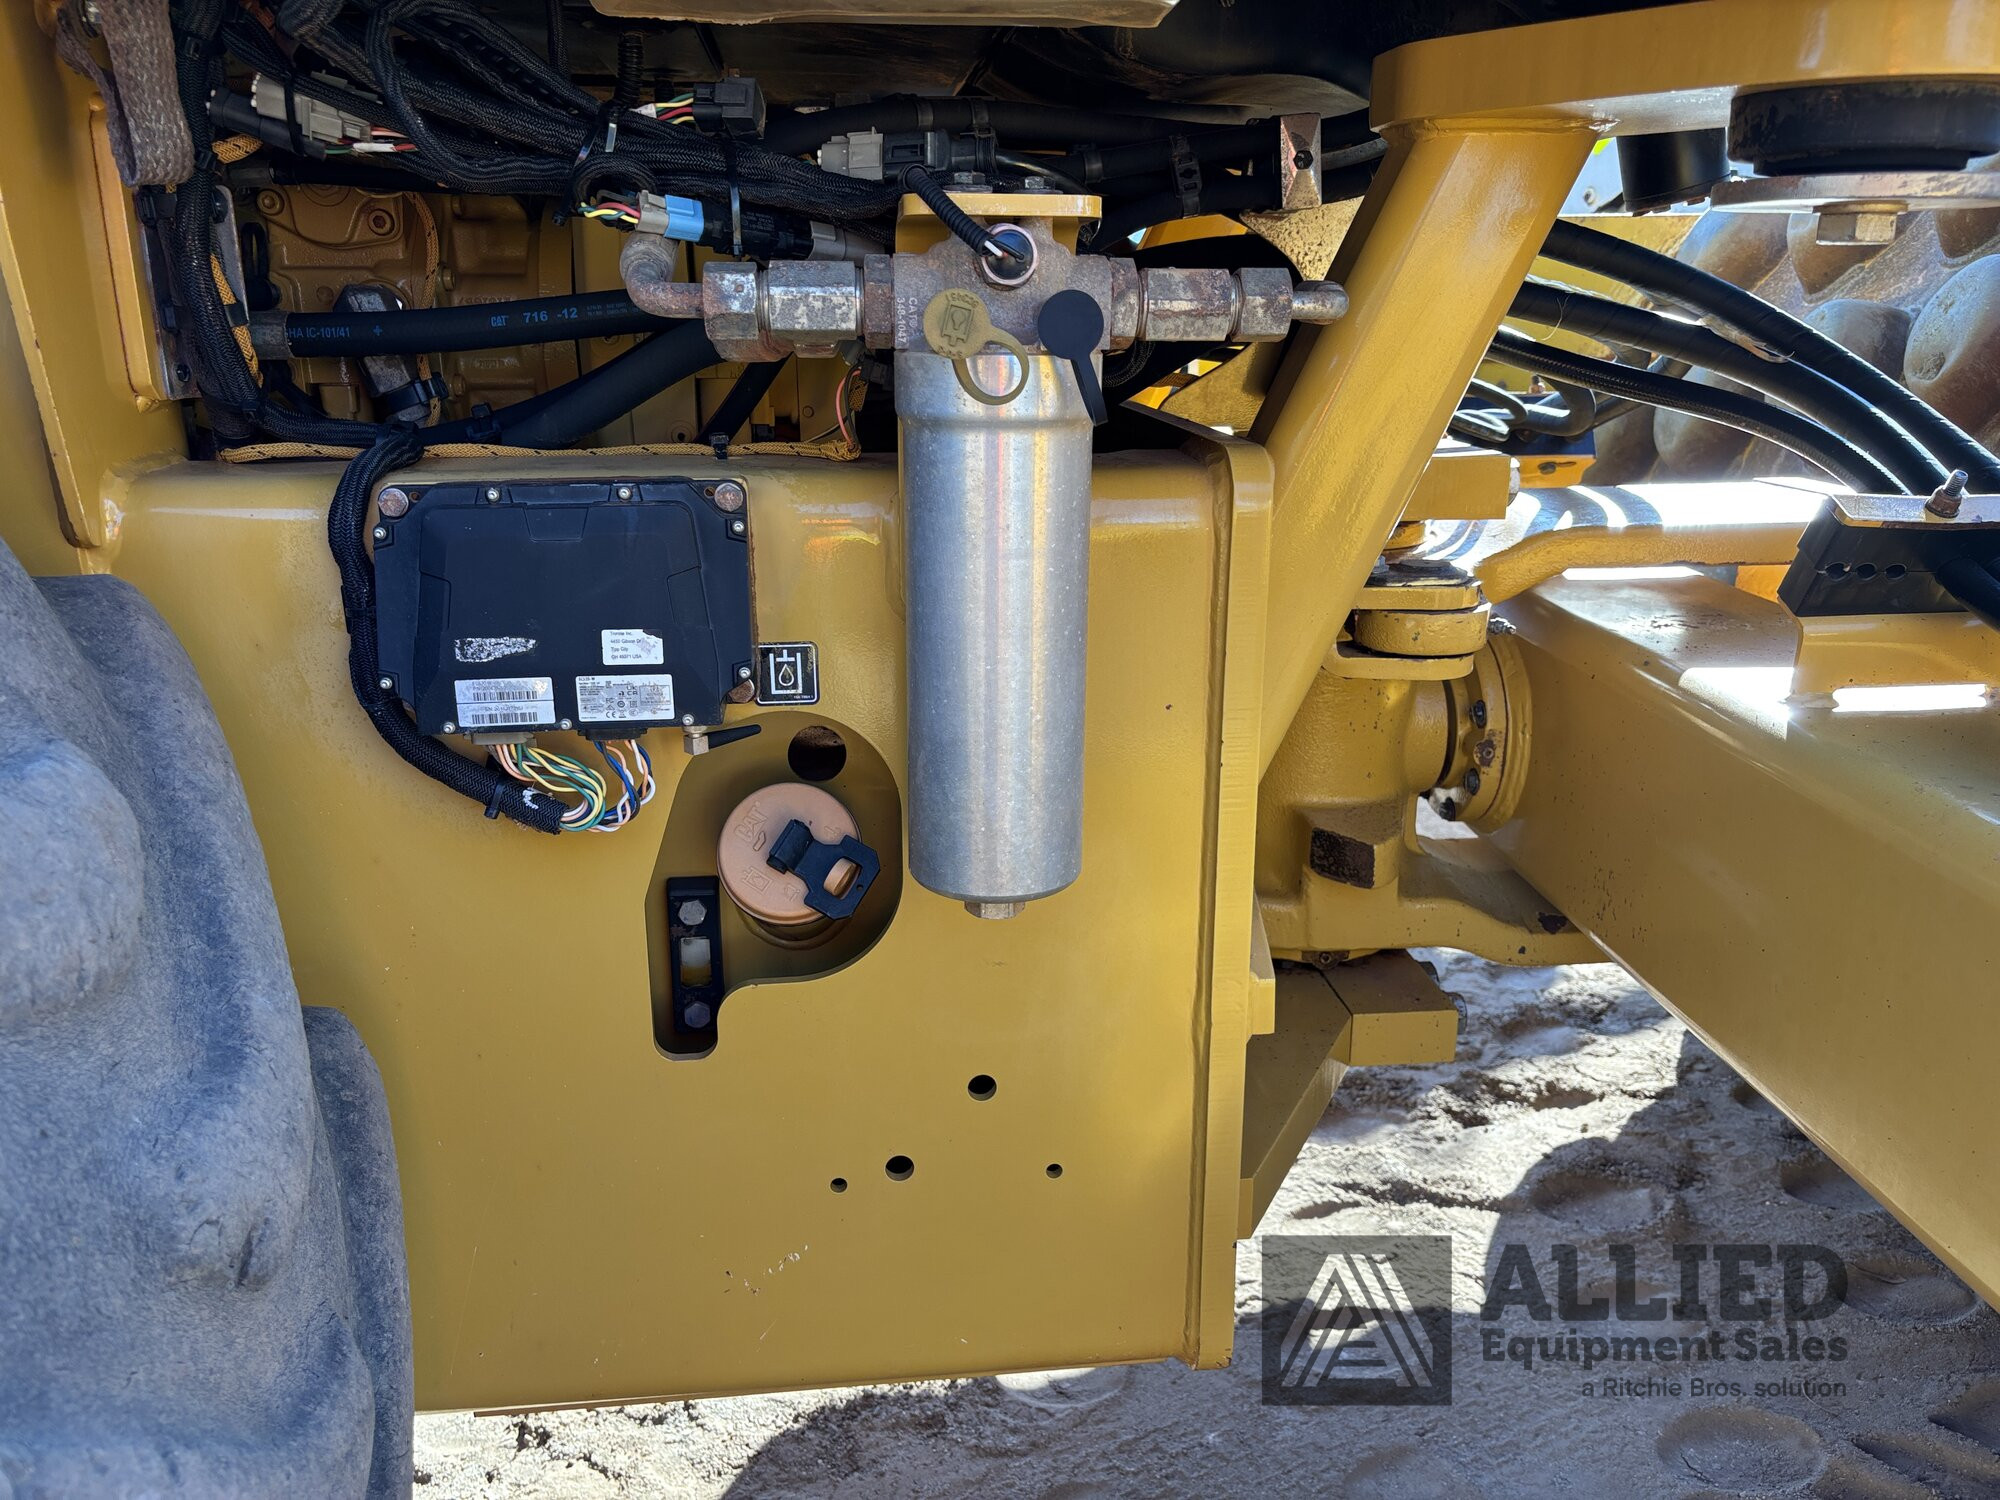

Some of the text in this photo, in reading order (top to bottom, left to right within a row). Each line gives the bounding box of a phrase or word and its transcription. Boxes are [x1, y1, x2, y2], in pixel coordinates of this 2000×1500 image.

[491, 315, 508, 327] CAT
[523, 311, 548, 323] 716
[557, 307, 578, 319] -12
[306, 326, 350, 338] IC-101/41
